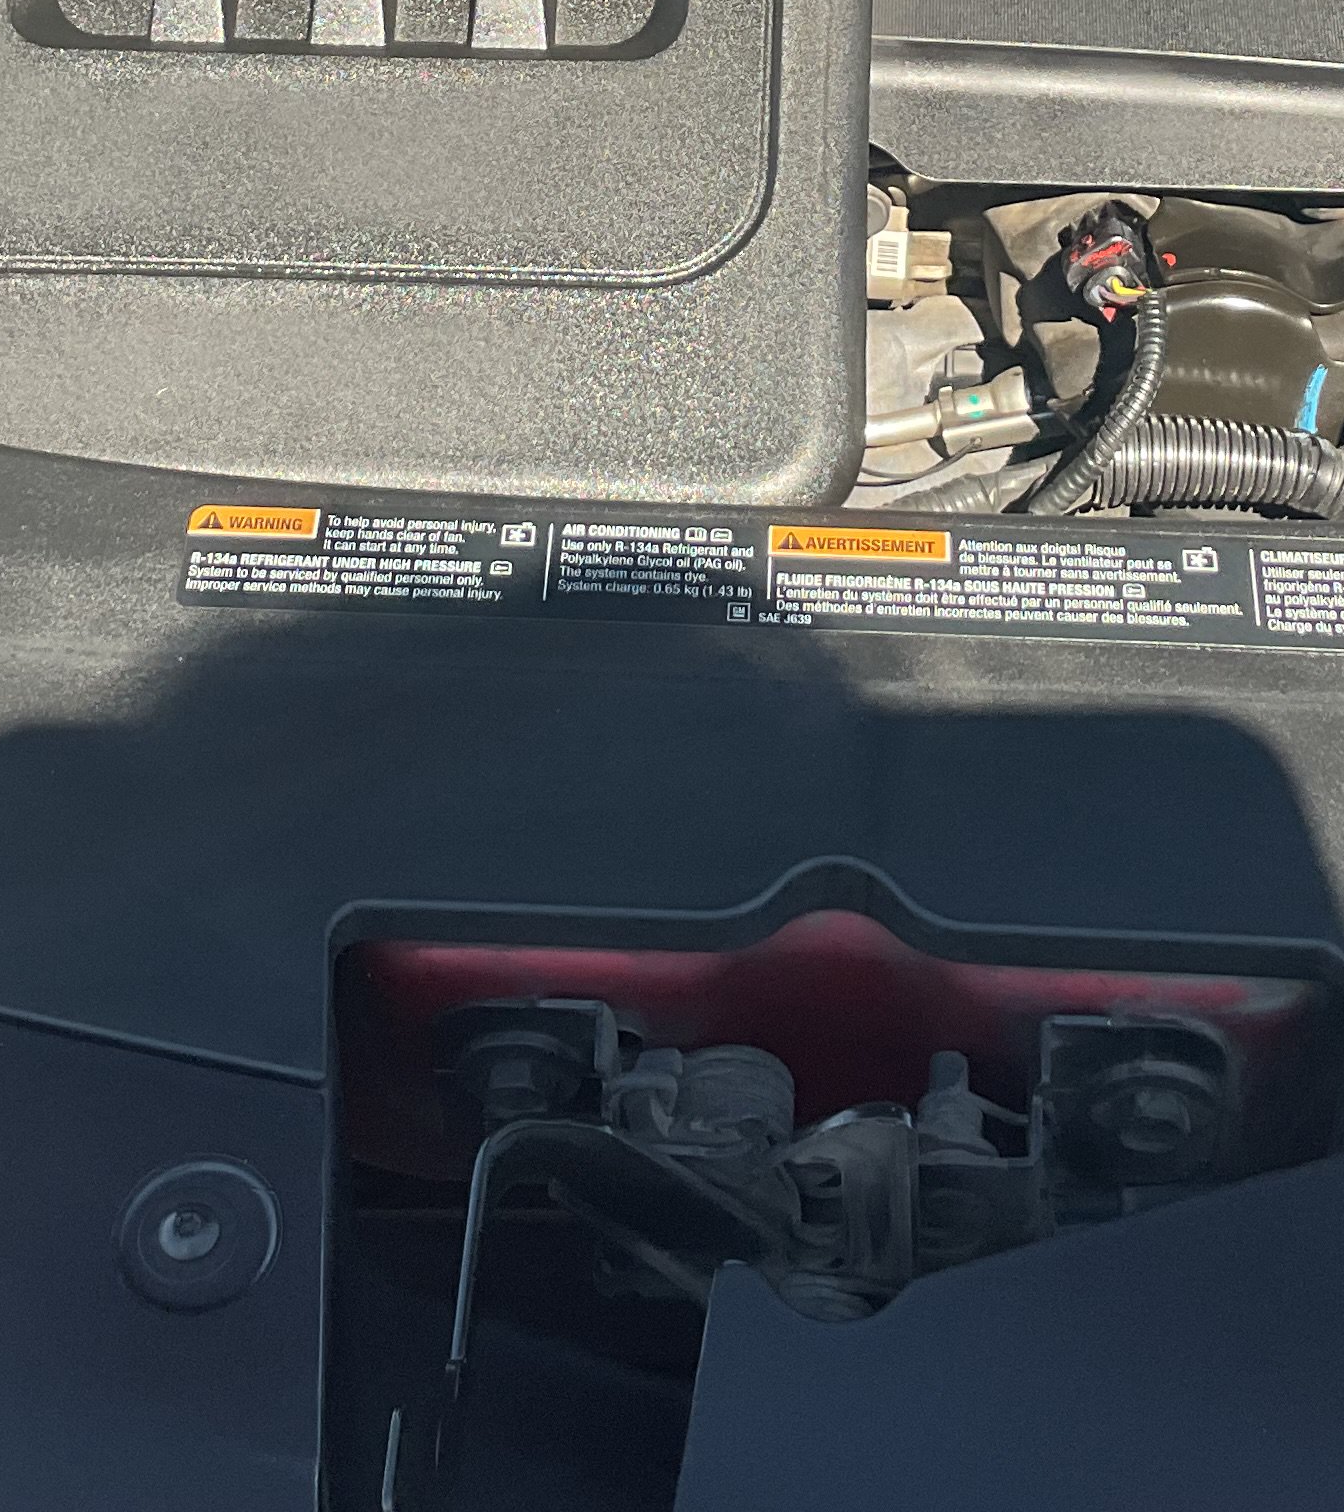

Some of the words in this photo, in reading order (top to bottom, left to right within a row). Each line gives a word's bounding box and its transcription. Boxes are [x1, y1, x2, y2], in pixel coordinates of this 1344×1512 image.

[229, 516, 303, 530] WARNING
[328, 514, 341, 527] To
[344, 516, 369, 529] help
[372, 517, 405, 528] avoid
[407, 519, 459, 531] personal
[326, 528, 354, 540] keep
[358, 529, 394, 540] hands
[396, 530, 427, 541] clear
[428, 531, 441, 541] of
[561, 524, 585, 536] AIR
[588, 525, 680, 539] CONDITIONING
[323, 539, 332, 550] It
[334, 541, 356, 551] can
[358, 540, 387, 552] start
[389, 541, 402, 553] at
[404, 543, 426, 556] any
[429, 543, 459, 555] time.
[561, 539, 584, 550] Use
[587, 540, 612, 554] only
[615, 541, 659, 553] R-134a
[663, 543, 729, 557] Refrigerant
[731, 546, 754, 557] and
[805, 536, 936, 554] AVERTISSEMENT
[958, 539, 1014, 553] Attention
[1016, 542, 1038, 554] aux
[1084, 543, 1126, 558] Risque
[190, 551, 237, 564] R-134a
[240, 553, 330, 567] REFRIGERANT
[332, 556, 376, 569] UNDER
[380, 558, 411, 570] HIGH
[414, 559, 482, 573] PRESSURE
[560, 552, 634, 567] Polyalkylene
[637, 555, 673, 568] Glycol
[676, 556, 690, 567] oil
[694, 558, 722, 570] (PAG
[959, 552, 975, 563] de
[977, 553, 1038, 565] blessures.
[1041, 555, 1056, 566] Le
[1060, 556, 1124, 568] ventilateur
[1126, 558, 1154, 571] peut
[1156, 560, 1172, 570] se
[187, 564, 233, 578] System
[236, 566, 248, 578] to
[251, 567, 267, 578] be
[269, 569, 321, 581] serviced
[323, 570, 338, 583] by
[341, 571, 392, 584] qualified
[395, 573, 454, 585] personnel
[560, 566, 582, 577] The
[585, 568, 627, 580] system
[631, 569, 681, 581] contains
[959, 565, 999, 576] mettre
[1013, 566, 1057, 578] tourner
[1060, 569, 1089, 580] sans
[1261, 566, 1305, 579] Utiliser
[186, 578, 241, 592] Improper
[243, 581, 286, 592] service
[290, 582, 342, 593] methods
[345, 585, 372, 597] may
[373, 586, 409, 596] cause
[412, 587, 464, 599] personal
[558, 579, 603, 592] System
[653, 583, 681, 594] 0.65
[684, 584, 699, 598] kg
[737, 586, 752, 598] lb)
[776, 572, 822, 586] FLUIDE
[825, 574, 912, 590] FRIGORIGÈNE
[914, 577, 960, 592] R-134a
[964, 580, 1000, 593] SOUS
[1002, 581, 1046, 595] HAUTE
[1049, 583, 1115, 597] PRESSION
[842, 589, 858, 600] du
[861, 589, 912, 604] système
[915, 592, 938, 604] doit
[1021, 598, 1042, 609] par
[1045, 598, 1060, 608] un
[1064, 598, 1124, 611] personnel
[1264, 594, 1281, 605] au
[758, 612, 781, 623] SAE
[784, 613, 812, 625] J639
[776, 599, 799, 612] Des
[803, 600, 862, 614] méthodes
[934, 605, 1002, 619] incorrectes
[1005, 609, 1054, 622] peuvent
[1056, 611, 1098, 623] causer
[1101, 612, 1124, 624] des
[1266, 605, 1282, 618] Le
[1267, 618, 1313, 634] Charge
[1316, 620, 1332, 633] du
